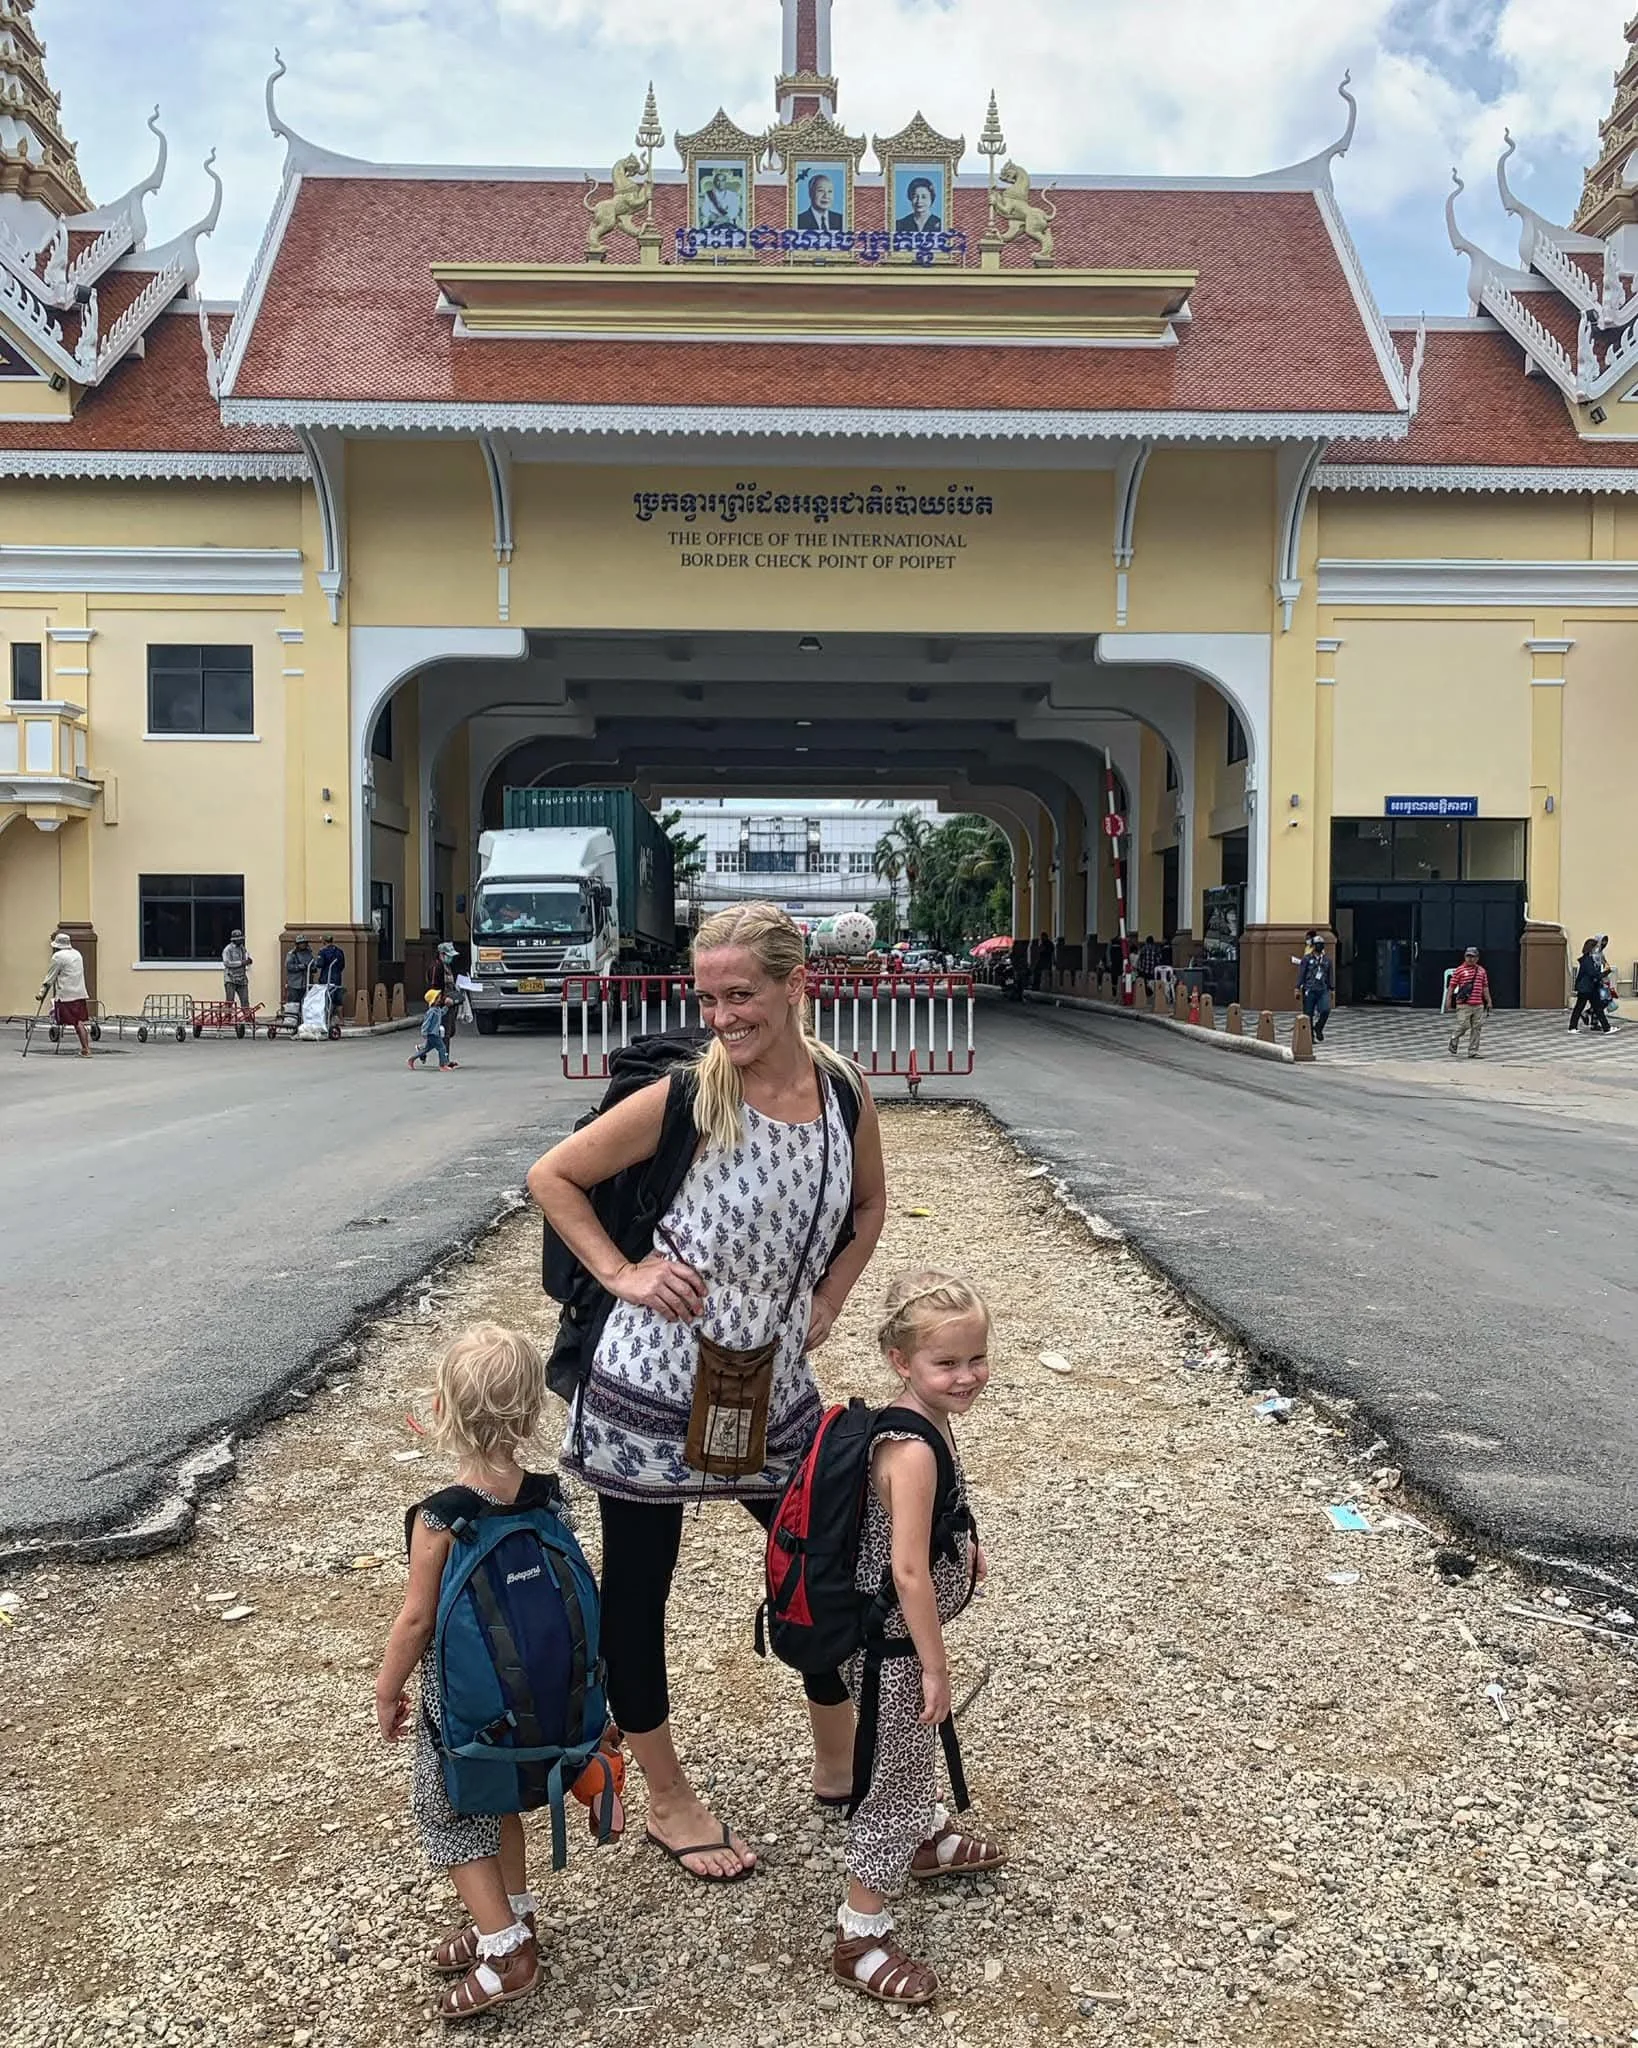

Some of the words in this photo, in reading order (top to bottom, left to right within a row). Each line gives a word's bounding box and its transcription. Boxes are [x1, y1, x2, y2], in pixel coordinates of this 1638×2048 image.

[667, 531, 701, 545] THE
[706, 531, 764, 546] OFFICE
[768, 532, 790, 547] OF
[795, 533, 828, 547] THE
[832, 534, 967, 548] INTERNATIONAL
[680, 553, 750, 567] BORDER
[755, 554, 811, 568] CHECK
[818, 555, 868, 569] POINT
[872, 555, 894, 569] OF
[900, 555, 957, 569] POIPET
